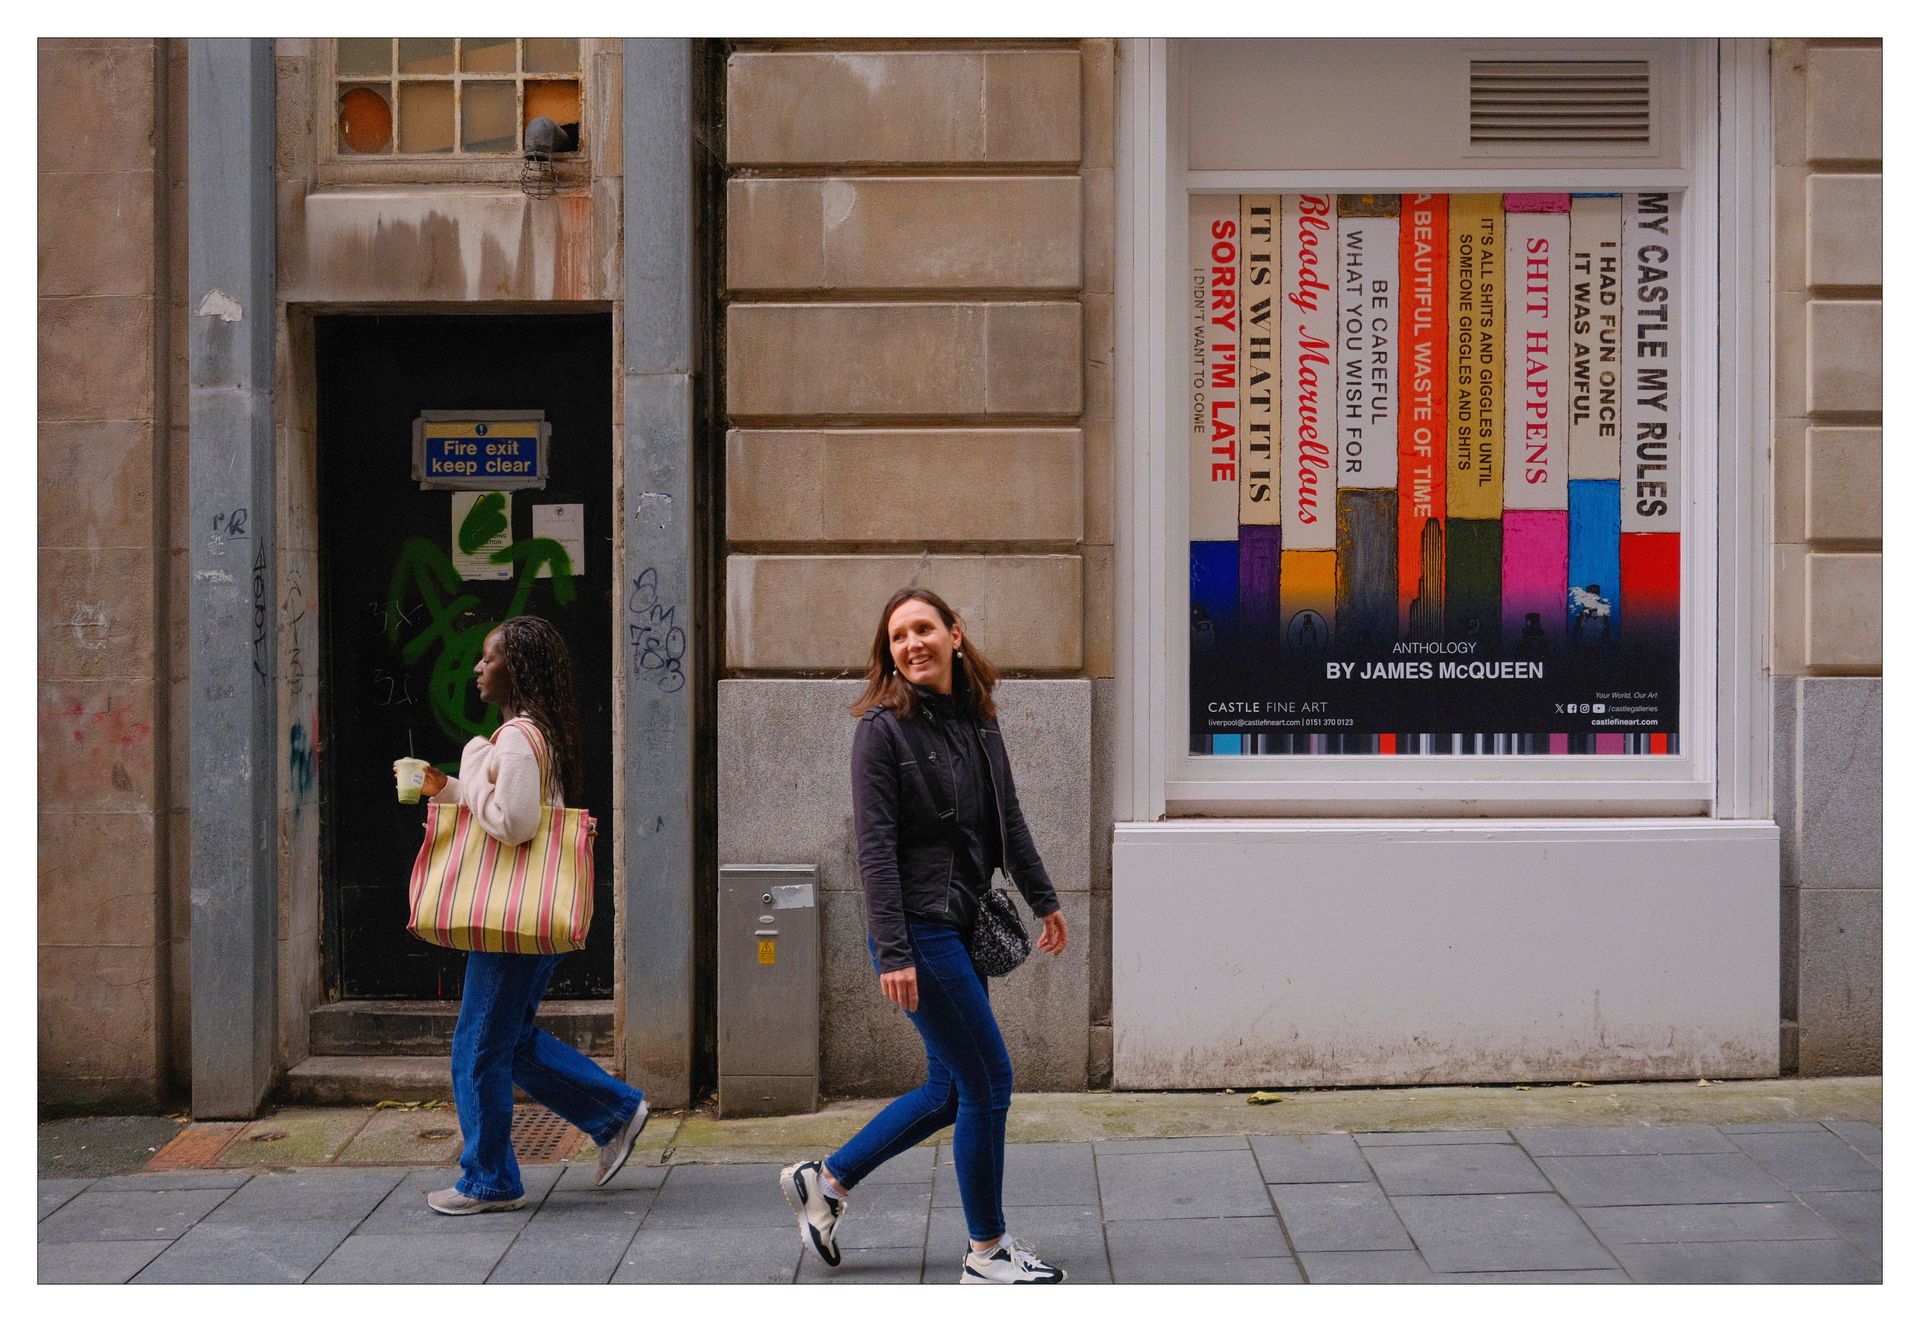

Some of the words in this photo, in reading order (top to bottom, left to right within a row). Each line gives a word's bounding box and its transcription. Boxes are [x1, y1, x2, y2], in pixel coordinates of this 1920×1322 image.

[1414, 194, 1432, 205] A
[1638, 193, 1669, 236] MY
[1250, 207, 1271, 243] IT
[1480, 218, 1494, 245] IT'S
[1211, 220, 1236, 332] SORRY
[1250, 255, 1271, 286] IS
[1288, 194, 1330, 313] Bloody
[1346, 230, 1363, 297] WHAT
[1414, 211, 1432, 336] BEAUTIFUL
[1459, 234, 1472, 312] SOMEONE
[1480, 251, 1494, 278] ALL
[1574, 253, 1591, 274] IT
[1194, 276, 1204, 324] DIDN'T
[1371, 281, 1388, 309] BE
[1526, 238, 1549, 318] SHIT
[1600, 256, 1616, 306] HAD
[1480, 284, 1493, 327] SHITS
[1574, 282, 1591, 334] WAS
[1637, 245, 1669, 358] CASTLE
[1194, 326, 1204, 366] WANT
[1346, 304, 1363, 350] YOU
[1480, 332, 1493, 364] AND
[1600, 314, 1616, 364] FUN
[1211, 344, 1236, 388] I'M
[1250, 297, 1271, 412] WHAT
[1371, 318, 1388, 425] CAREFUL
[1459, 316, 1472, 384] GIGGLES
[1194, 370, 1204, 389] TO
[1346, 359, 1363, 419] WISH
[1414, 341, 1432, 421] WASTE
[1573, 342, 1590, 425] AWFUL
[1637, 369, 1668, 412] MY
[1194, 392, 1204, 434] COME
[1298, 325, 1330, 525] Marvellous
[1459, 389, 1472, 421] AND
[1480, 369, 1493, 437] GIGGLES
[1526, 330, 1549, 484] HAPPENS
[1600, 371, 1615, 437] ONCE
[444, 441, 477, 455] Fire
[485, 441, 519, 455] exit
[1211, 402, 1236, 482] LATE
[1250, 424, 1271, 460] IT
[1346, 428, 1363, 474] FOR
[1414, 428, 1432, 457] OF
[1458, 427, 1471, 470] SHITS
[432, 458, 478, 475] keep
[485, 458, 531, 472] clear
[1250, 471, 1271, 503] IS
[1479, 443, 1493, 487] UNTIL
[1636, 422, 1668, 517] RULES
[1413, 465, 1432, 518] TIME
[1327, 662, 1355, 679] BY
[1360, 662, 1433, 679] JAMES
[1439, 662, 1543, 679] McQUEEN
[1393, 642, 1476, 654] ANTHOLOGY
[1208, 702, 1260, 712] CASTLE
[1267, 702, 1295, 712] FINE
[1301, 702, 1328, 712] ART
